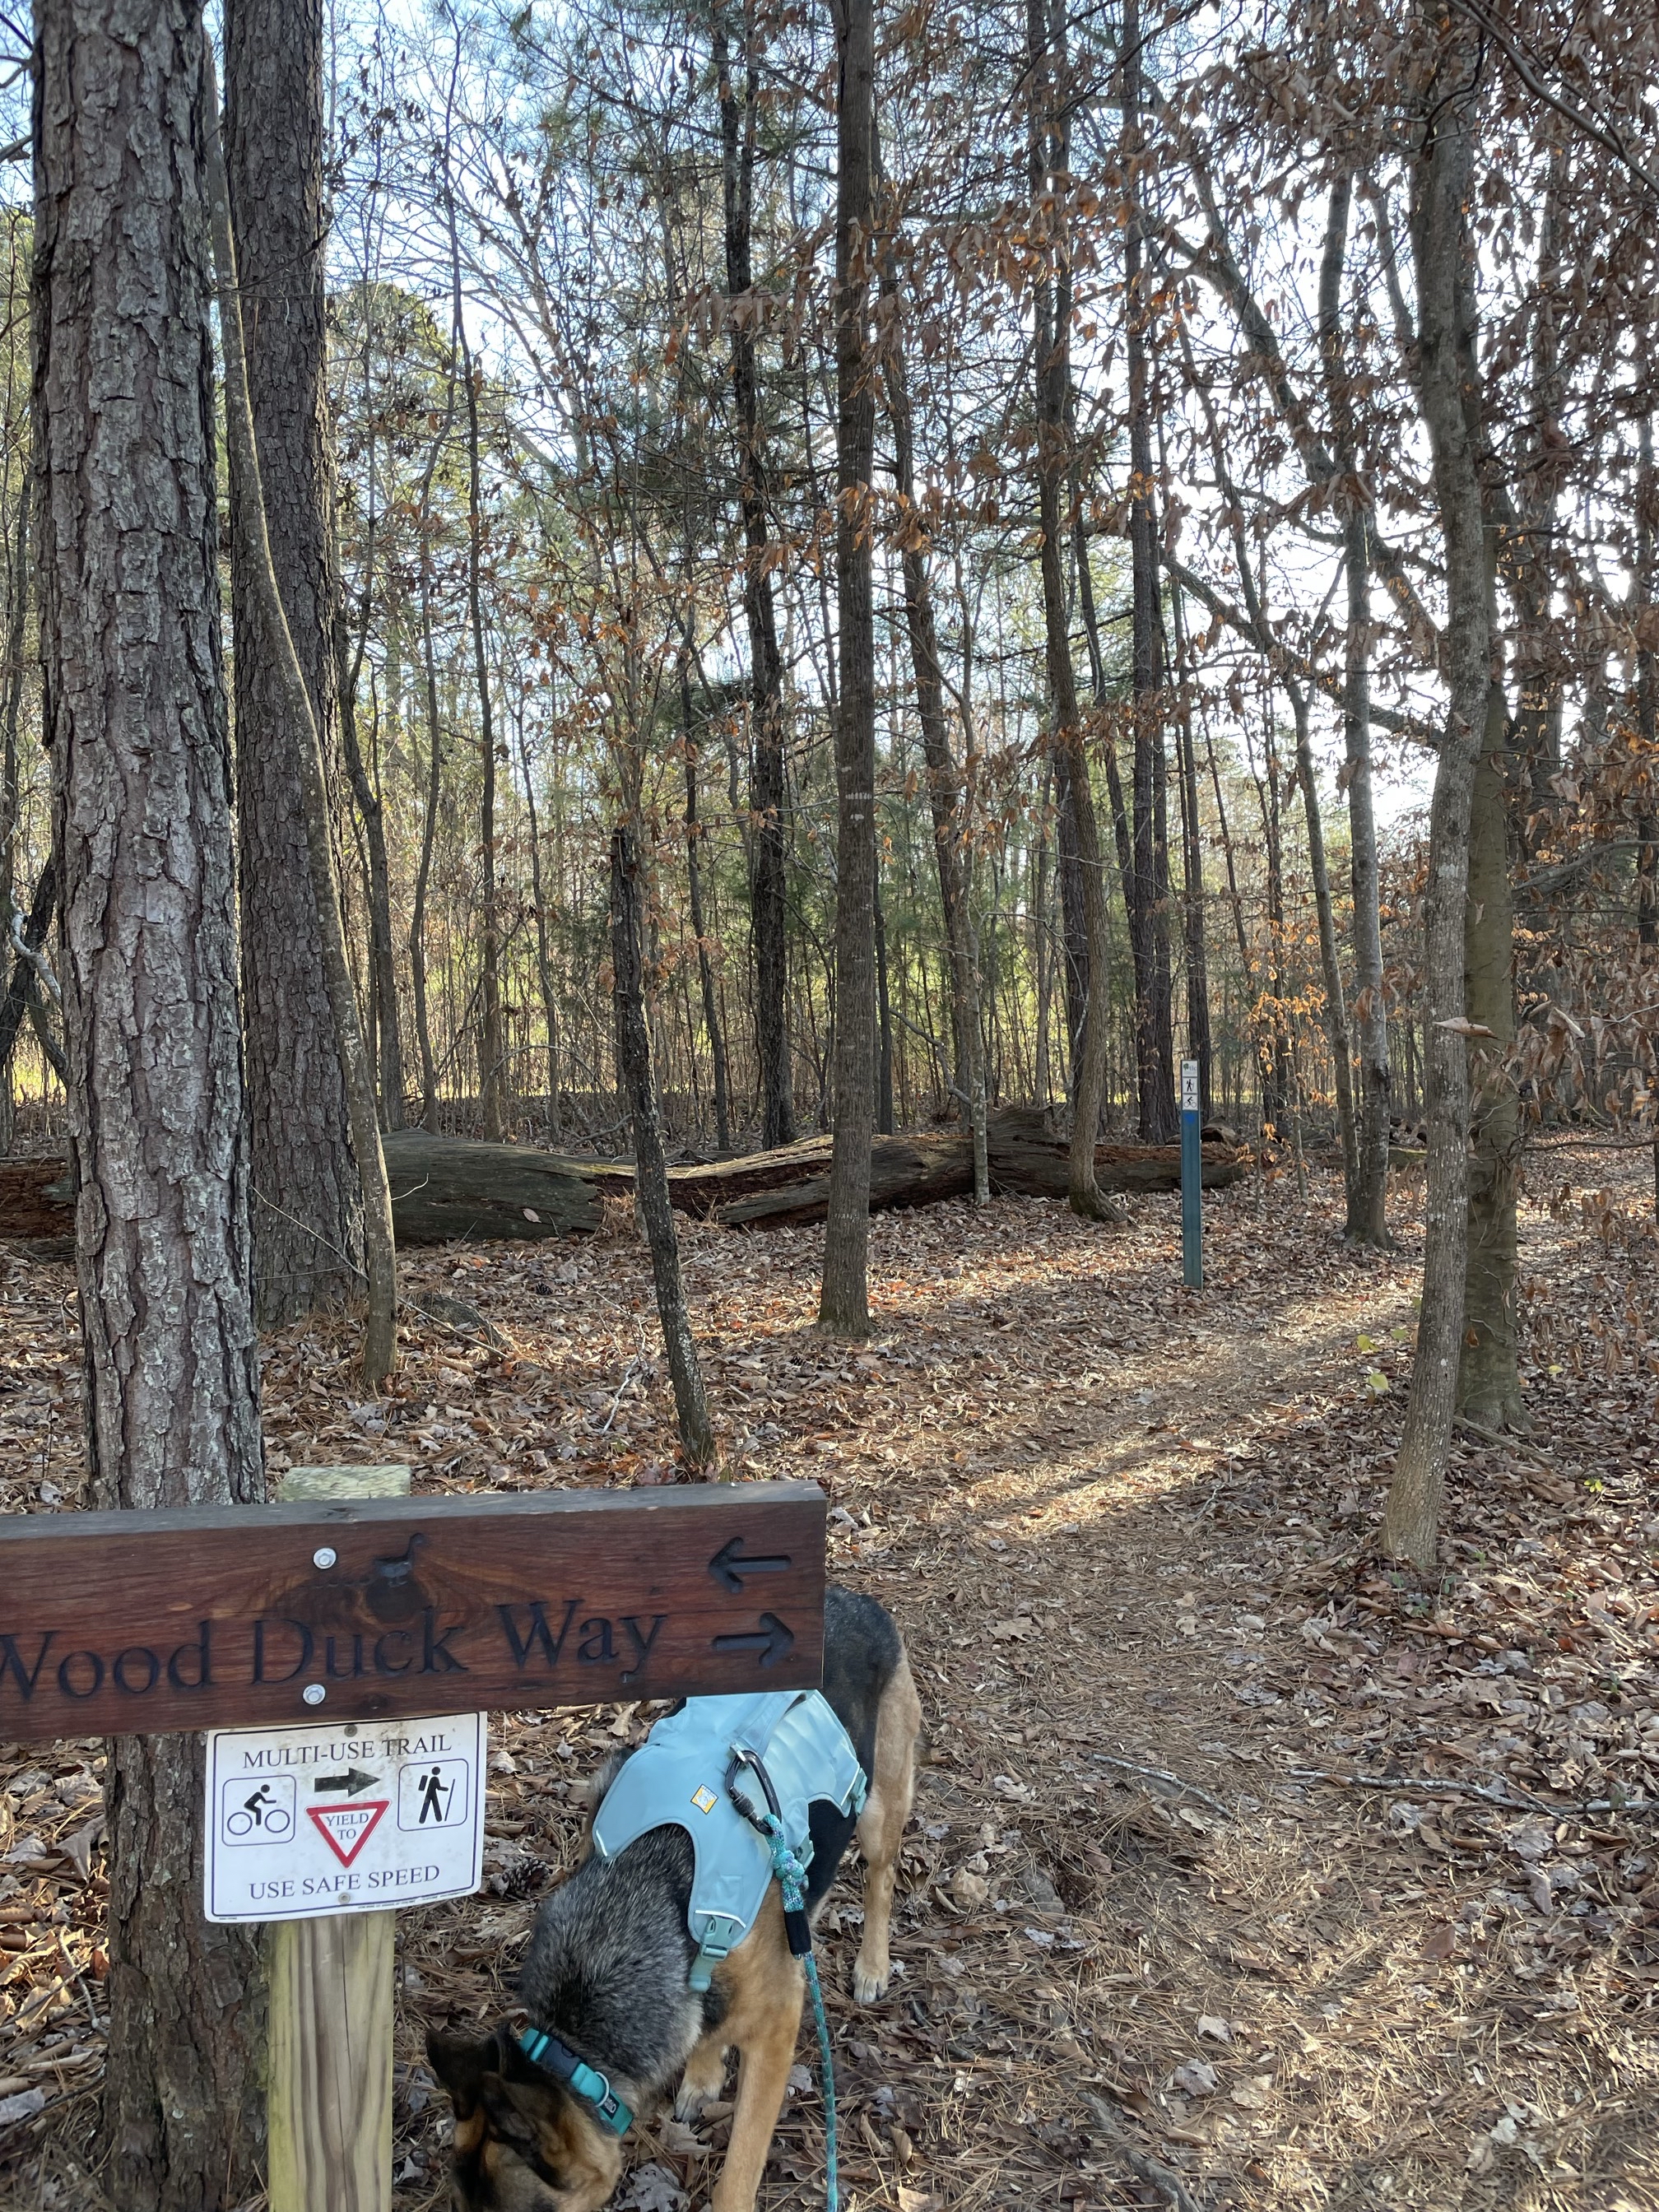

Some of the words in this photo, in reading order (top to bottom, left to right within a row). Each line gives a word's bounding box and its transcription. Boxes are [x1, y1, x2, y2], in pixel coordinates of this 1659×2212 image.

[251, 1606, 470, 1685] Duck
[495, 1599, 668, 1683] Way
[243, 1740, 375, 1769] MULTI-USE
[381, 1734, 453, 1757] TRAIL
[325, 1812, 369, 1827] YIELD
[337, 1829, 357, 1841] TO
[249, 1880, 295, 1900] USE
[302, 1873, 361, 1895] SAFE
[368, 1864, 440, 1889] SPEED
